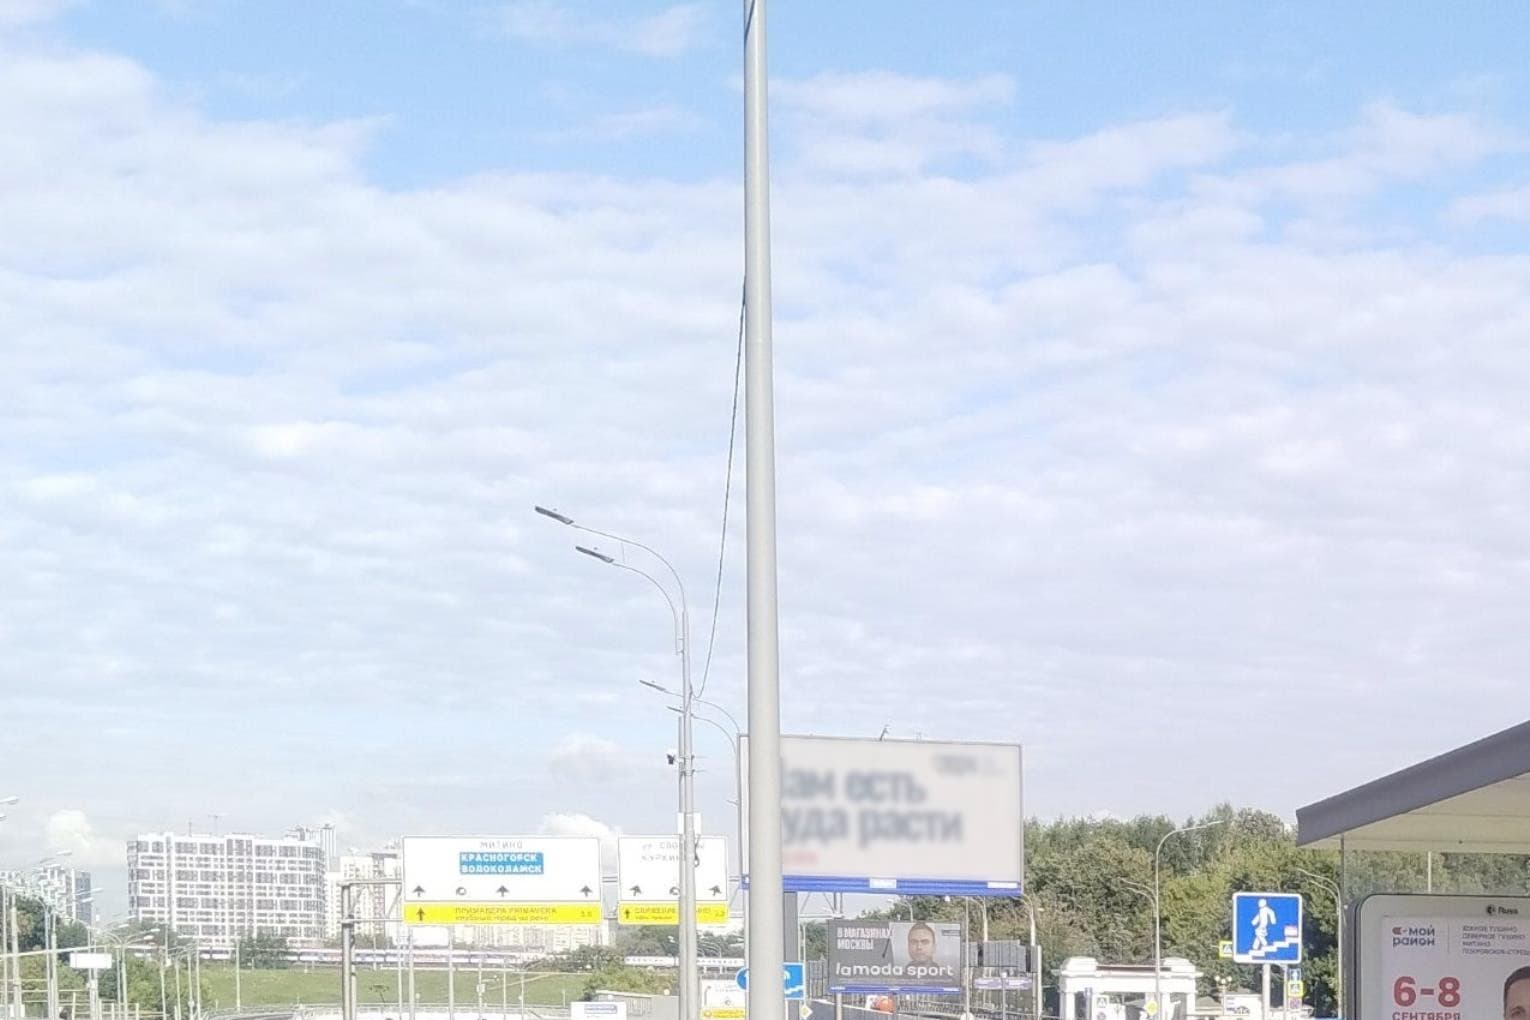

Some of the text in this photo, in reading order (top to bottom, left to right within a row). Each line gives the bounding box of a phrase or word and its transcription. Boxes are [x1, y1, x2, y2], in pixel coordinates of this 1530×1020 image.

[858, 809, 964, 851] расти
[460, 853, 538, 863] КРАСНОГОРСК
[461, 864, 542, 874] ВОЛОКОЛАМСК
[1408, 924, 1436, 937] мой
[1392, 936, 1436, 948] район
[835, 962, 954, 979] lamoda sport
[1392, 975, 1462, 1008] 6-8
